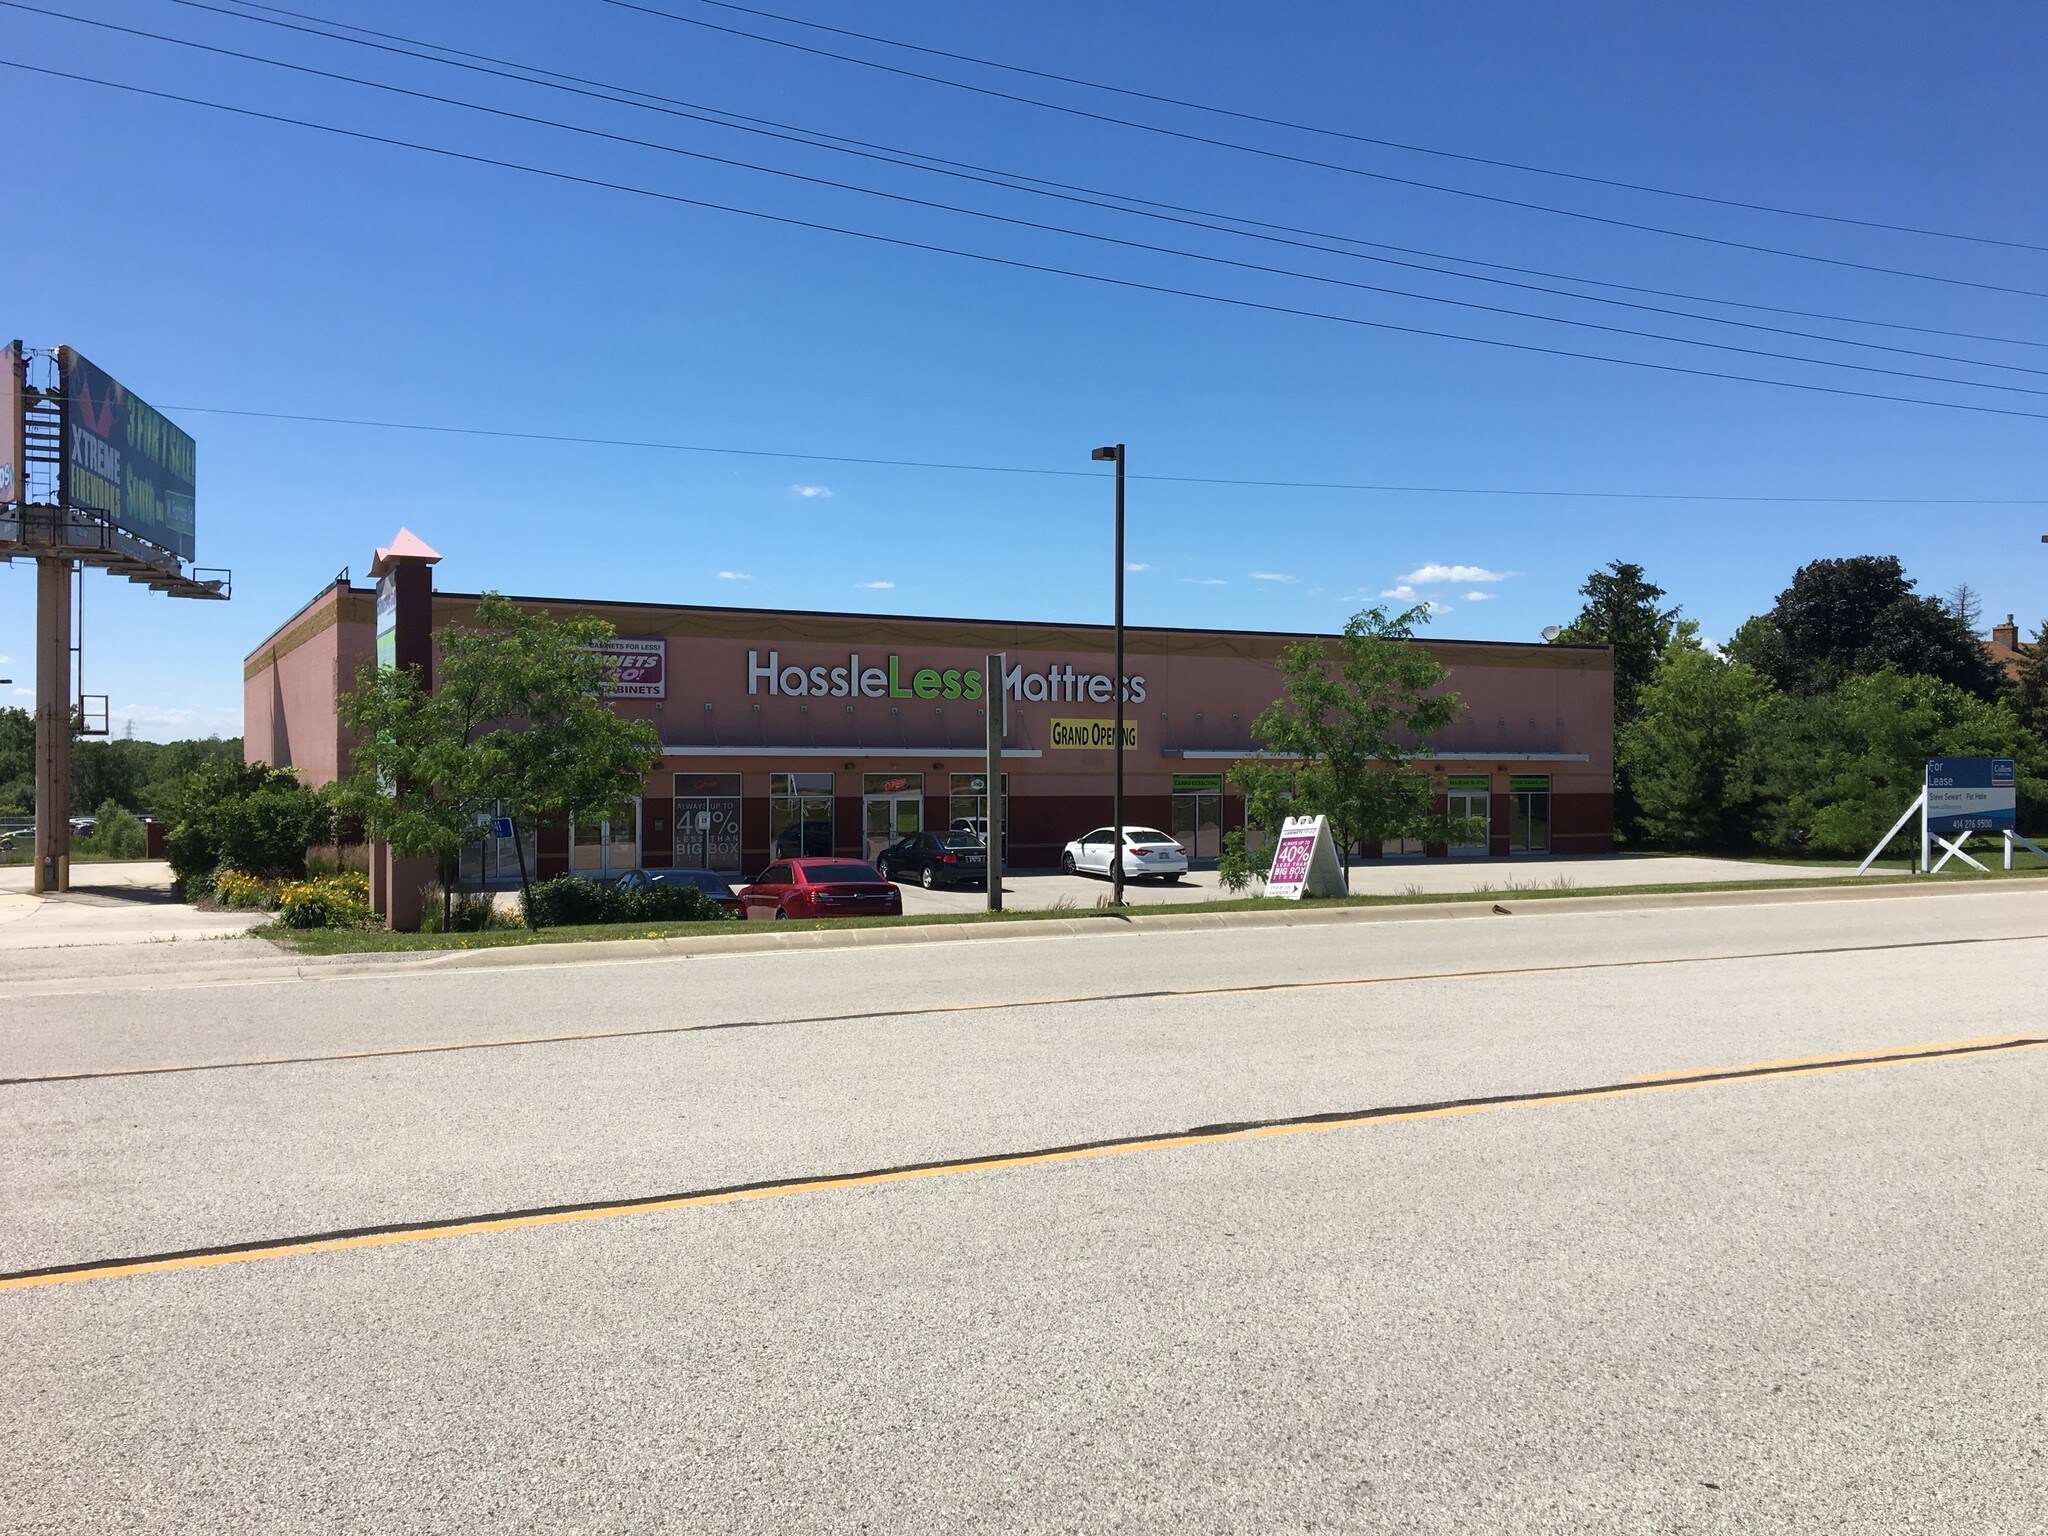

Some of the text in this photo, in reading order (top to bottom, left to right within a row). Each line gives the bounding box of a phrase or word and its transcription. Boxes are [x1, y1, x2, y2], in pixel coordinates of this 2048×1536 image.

[71, 423, 121, 485] XTREME
[70, 463, 121, 519] FIREWORKS
[589, 642, 625, 650] CABNETS
[1053, 722, 1136, 747] GRAND OPENG
[1928, 760, 1944, 772] For
[1928, 775, 1954, 786] Lease
[1952, 819, 1993, 829] 414 276 9500
[676, 835, 703, 843] LESS
[676, 843, 739, 855] BIG BOX
[1279, 845, 1309, 862] 40%
[1274, 867, 1306, 876] BIG BOX
